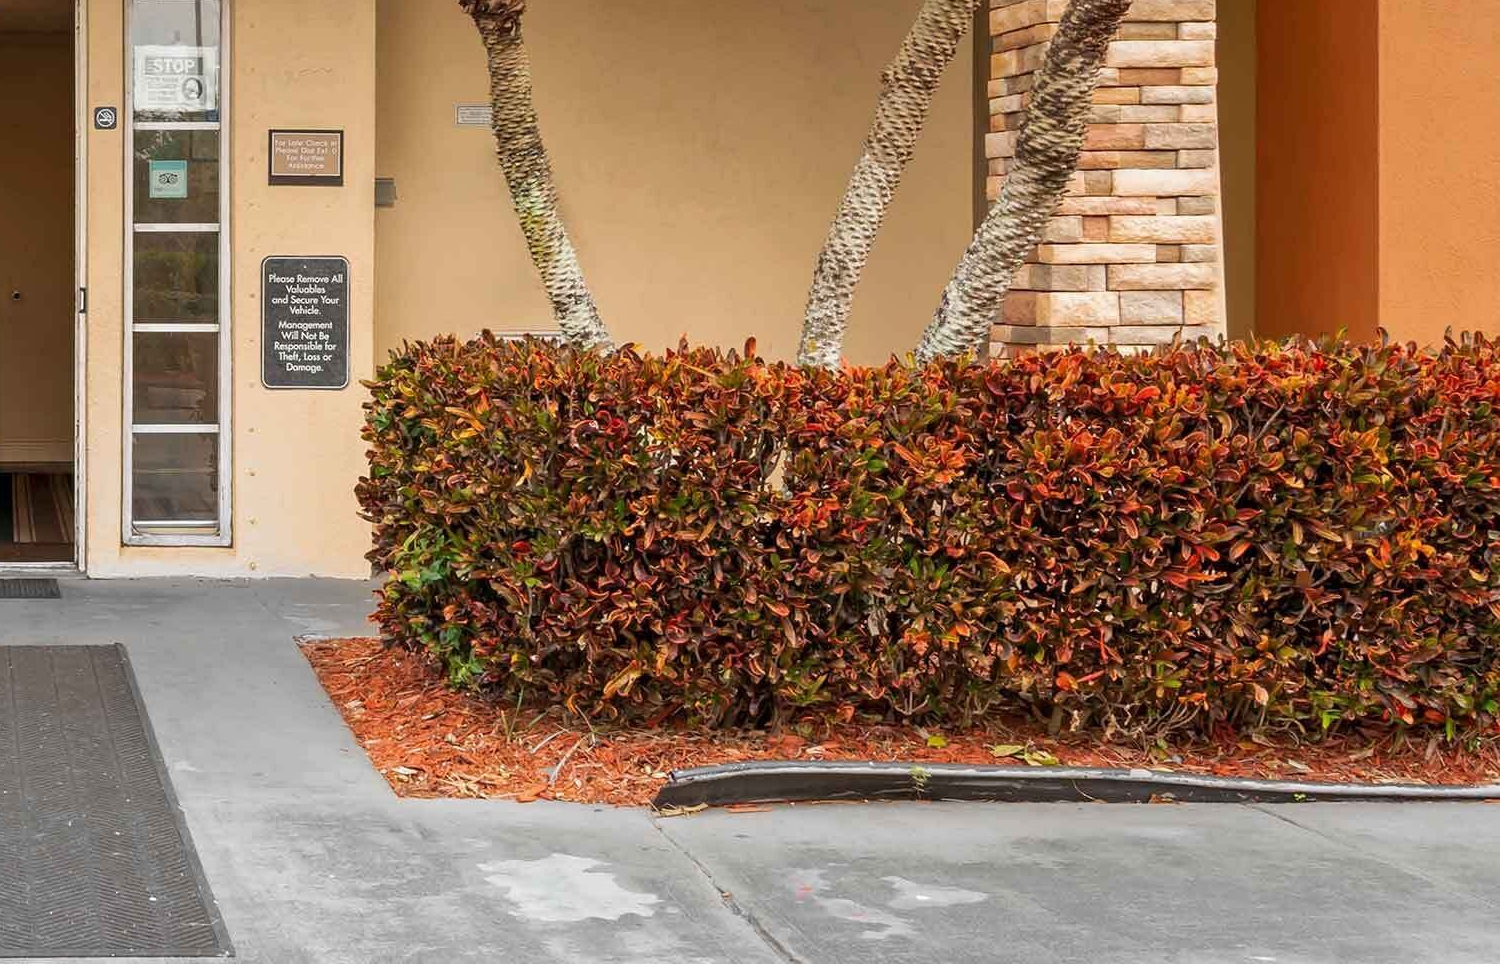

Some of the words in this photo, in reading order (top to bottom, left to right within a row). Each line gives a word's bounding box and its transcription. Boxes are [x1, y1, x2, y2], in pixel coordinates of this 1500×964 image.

[153, 58, 196, 73] STOP
[268, 274, 295, 284] Please
[297, 274, 329, 284] Remove
[331, 274, 344, 284] All
[286, 284, 326, 294] Valuables
[272, 295, 288, 305] and
[291, 295, 319, 305] Secure
[321, 295, 340, 305] Your
[289, 305, 322, 315] Vehicle.
[278, 321, 333, 331] Management
[281, 331, 299, 340] Will
[301, 331, 317, 340] Not
[319, 332, 330, 340] Be
[274, 341, 323, 352] Responsible
[325, 341, 337, 351] for
[279, 351, 301, 362] Theft,
[303, 352, 320, 361] Loss
[323, 353, 332, 361] or
[286, 363, 324, 374] Damage.
